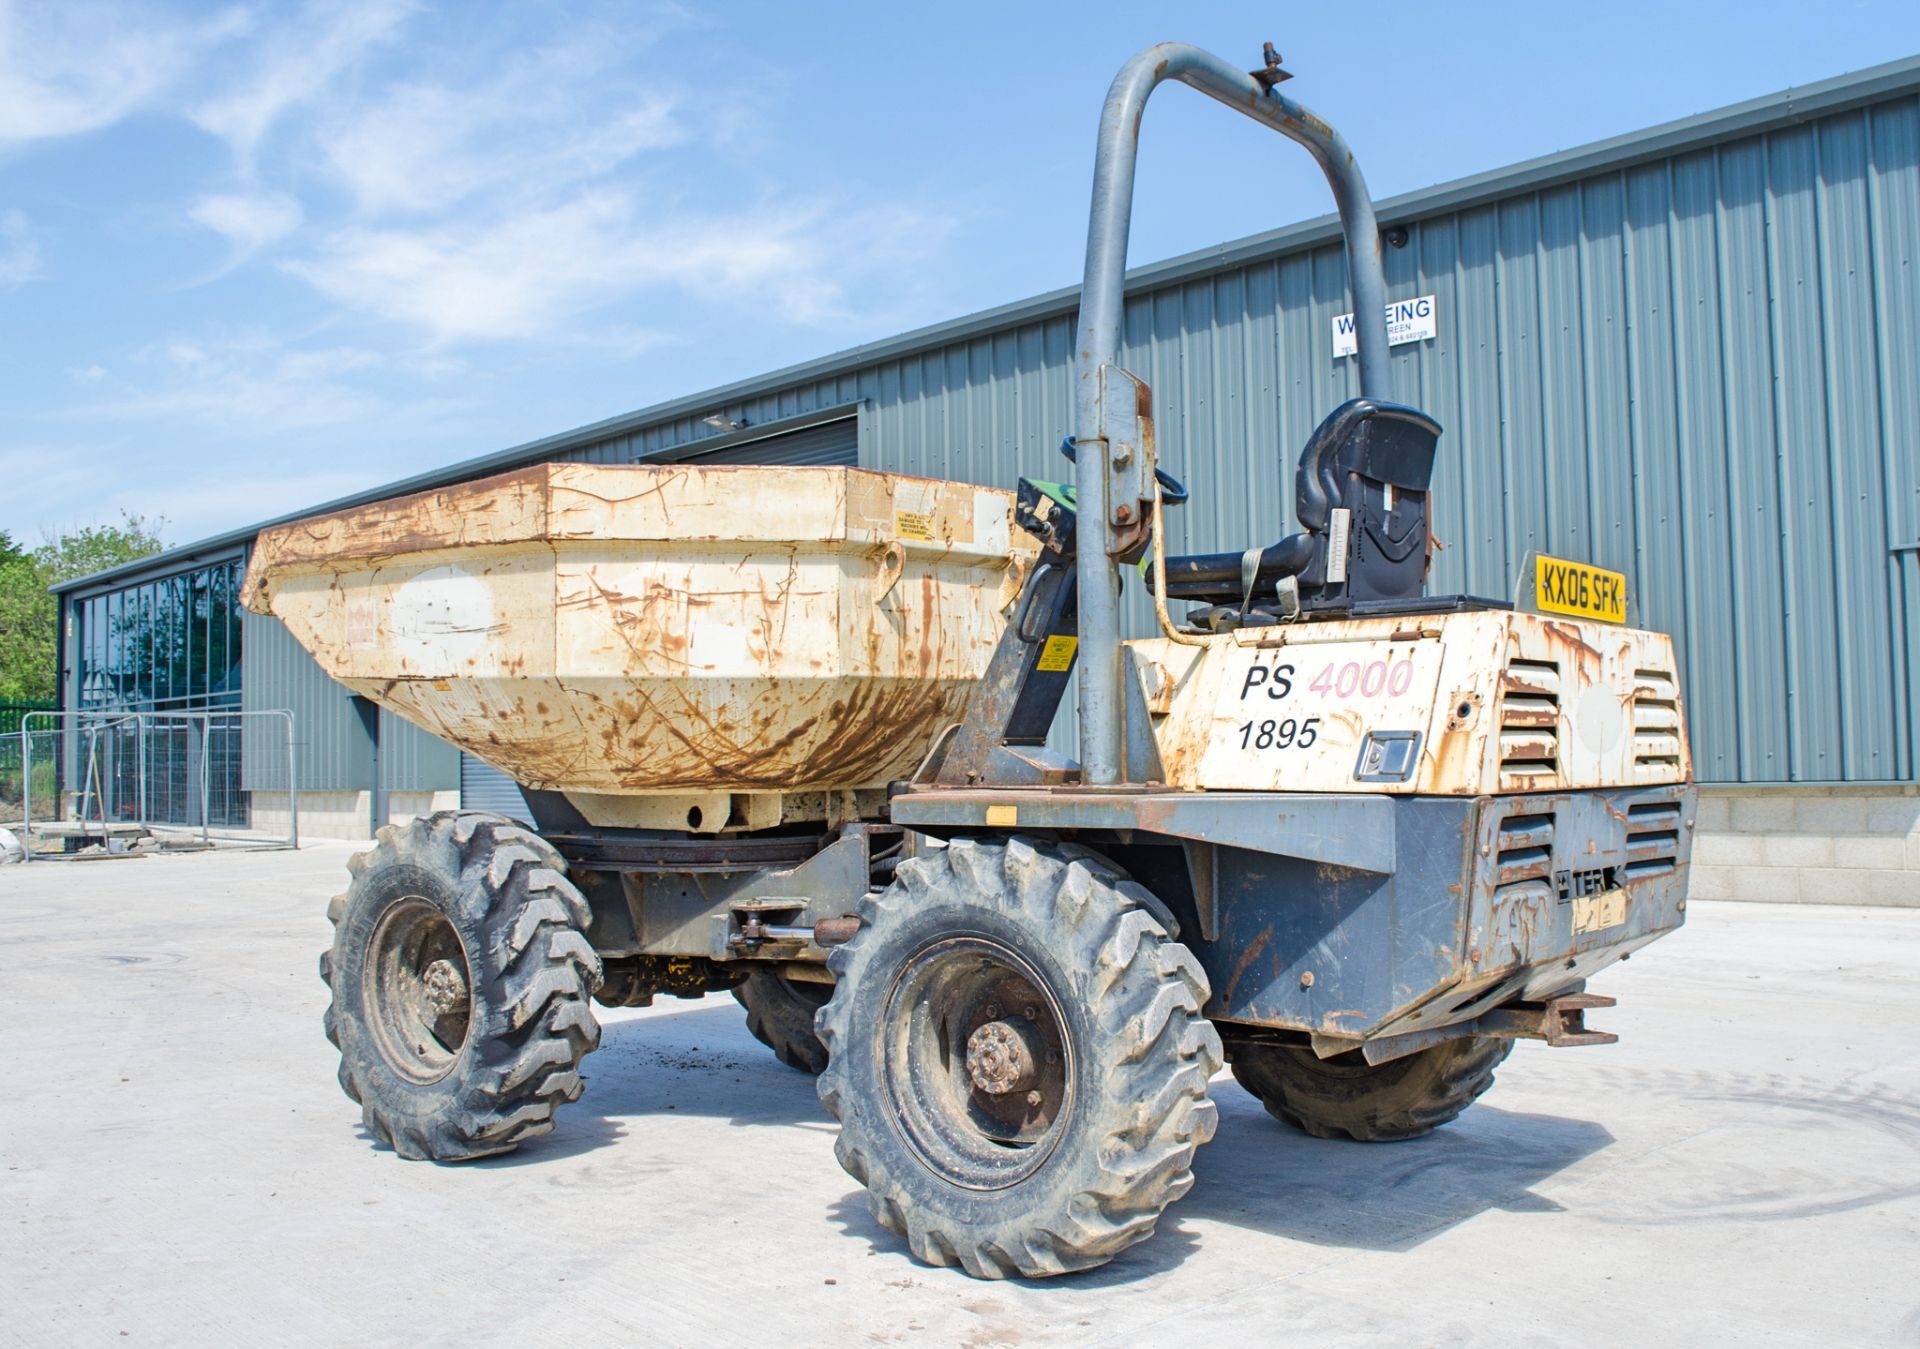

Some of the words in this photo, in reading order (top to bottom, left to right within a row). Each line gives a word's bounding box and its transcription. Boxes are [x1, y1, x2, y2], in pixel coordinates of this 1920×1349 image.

[1544, 562, 1588, 609] KX06
[1593, 573, 1619, 615] SFK
[1240, 664, 1295, 700] PS
[1309, 659, 1414, 698] 4000
[1238, 717, 1320, 750] 1895
